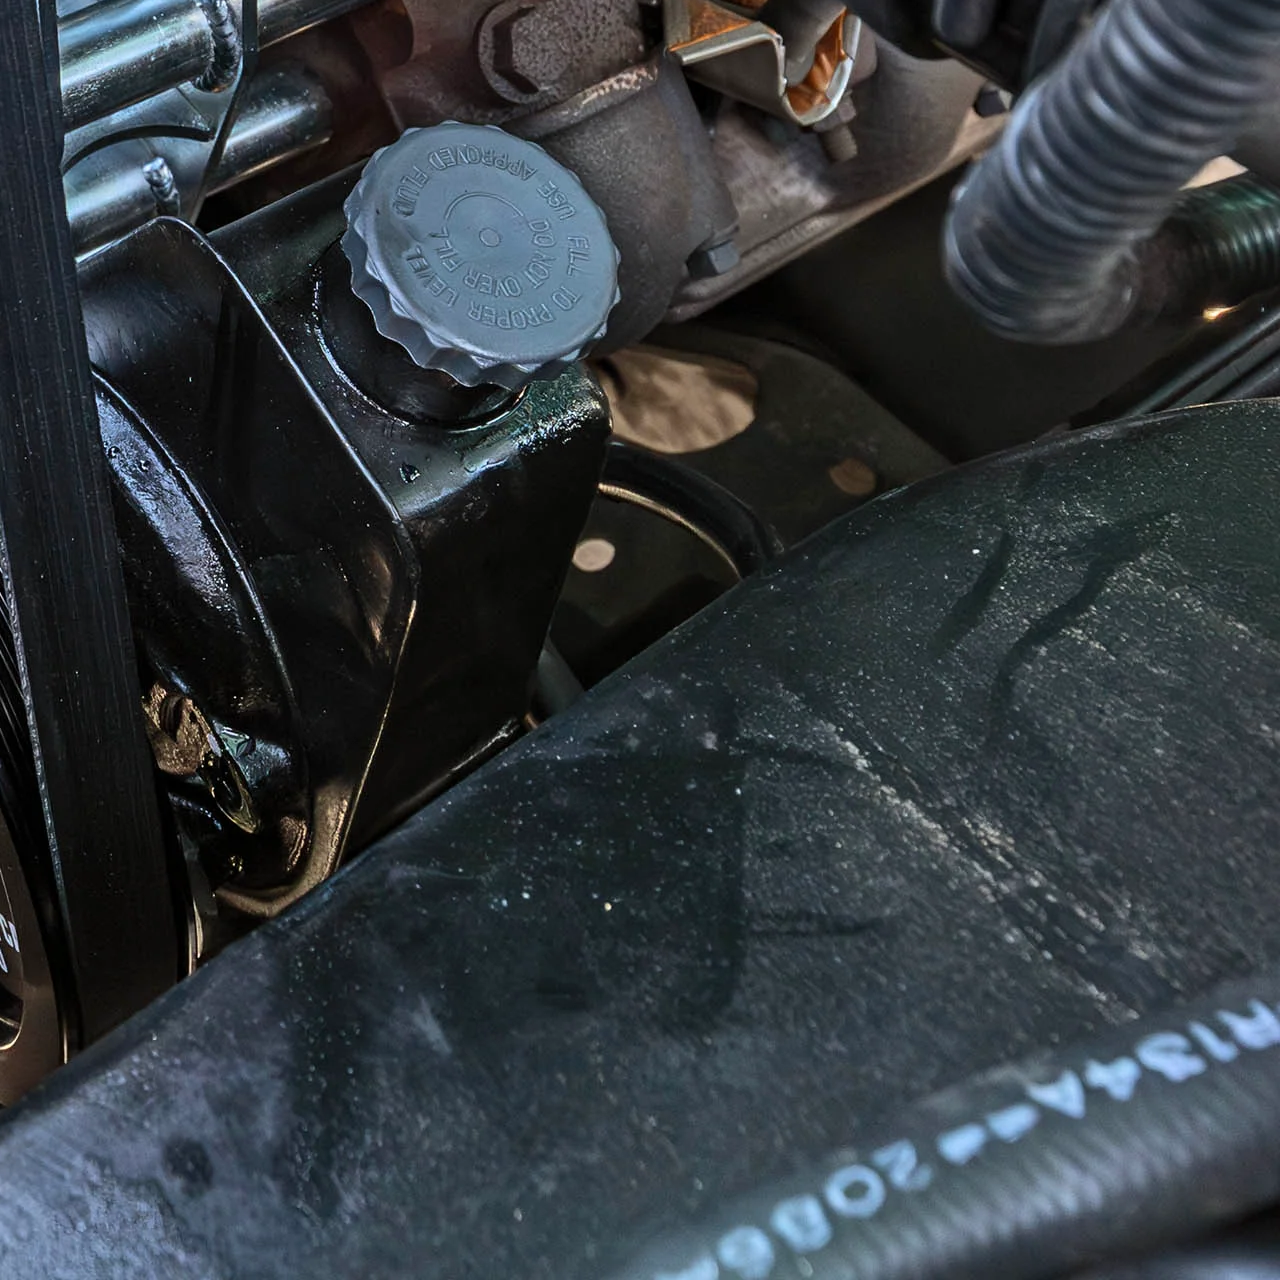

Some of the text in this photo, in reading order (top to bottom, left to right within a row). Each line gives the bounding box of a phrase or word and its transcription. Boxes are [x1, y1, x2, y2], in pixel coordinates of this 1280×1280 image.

[393, 144, 577, 221] USE APPROVED FLUID
[405, 235, 591, 330] FILL TO PROPER LEVEL
[428, 218, 558, 298] DO NOT OVER FILL
